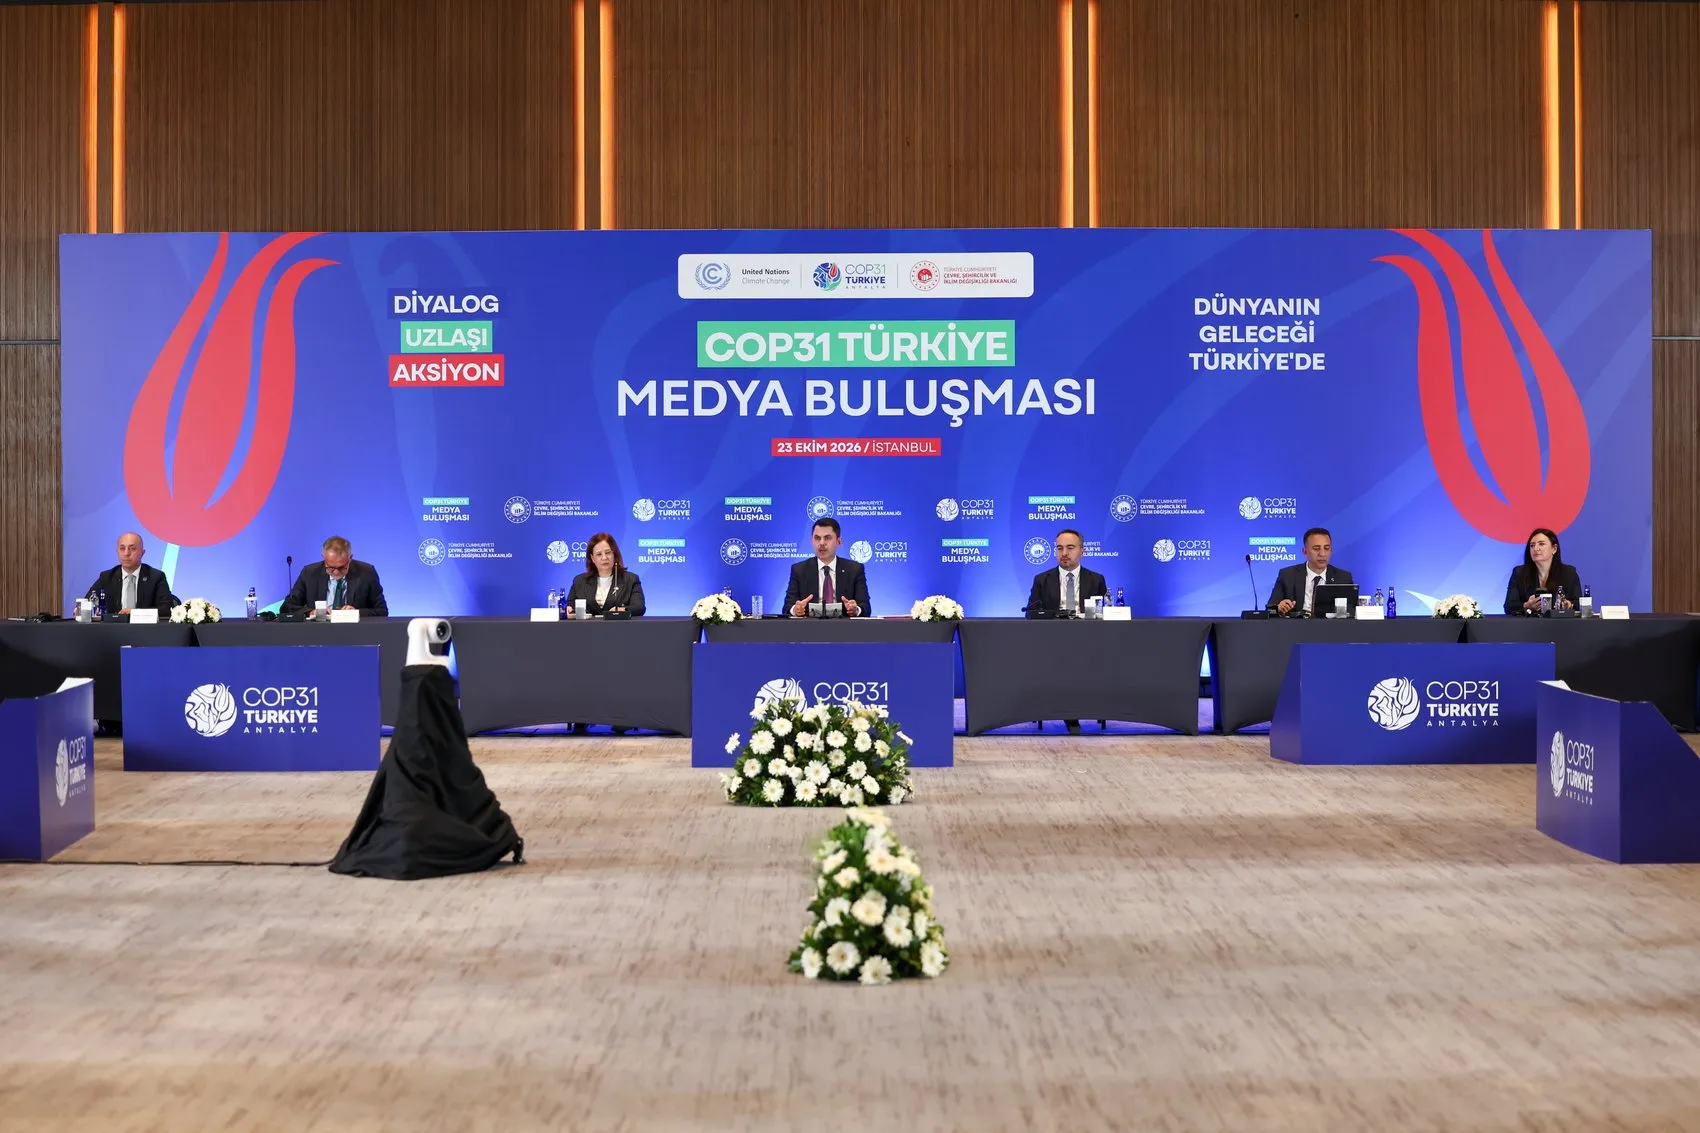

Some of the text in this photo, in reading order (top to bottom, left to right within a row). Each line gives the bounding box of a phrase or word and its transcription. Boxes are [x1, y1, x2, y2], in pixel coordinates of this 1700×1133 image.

[845, 264, 886, 275] COP31
[766, 278, 790, 286] Change
[394, 290, 499, 314] DİYALOG
[1194, 293, 1320, 316] DÜNYANIN
[1199, 320, 1315, 342] GELECEĞİ
[406, 328, 488, 352] UZLAŞI
[705, 322, 1008, 362] COP31 TÜRKİYE
[1188, 348, 1326, 370] TÜRKİYE'DE
[393, 358, 500, 382] AKSİYON
[618, 378, 1095, 428] MEDYA BULUŞMASI
[777, 440, 936, 453] 23 EKİM 2026 / İSTANBUL
[658, 500, 690, 508] COP31
[961, 500, 994, 508] COP31
[1264, 498, 1296, 506] COP31
[423, 514, 470, 522] BULUŞMASI
[725, 514, 772, 522] BULUŞMASI
[1029, 513, 1075, 521] BULUŞMASI
[875, 542, 908, 550] COP31
[1178, 541, 1210, 549] COP31
[638, 556, 685, 564] BULUŞMASI
[942, 555, 988, 564] BULUŞMASI
[1250, 554, 1296, 562] BULUŞMASI
[243, 687, 318, 706] COP31
[814, 682, 888, 702] COP31
[1426, 681, 1499, 700] COP31
[244, 726, 318, 734] ANTALYA
[1567, 740, 1594, 771] COP31
[1566, 790, 1592, 805] ANTALYA
